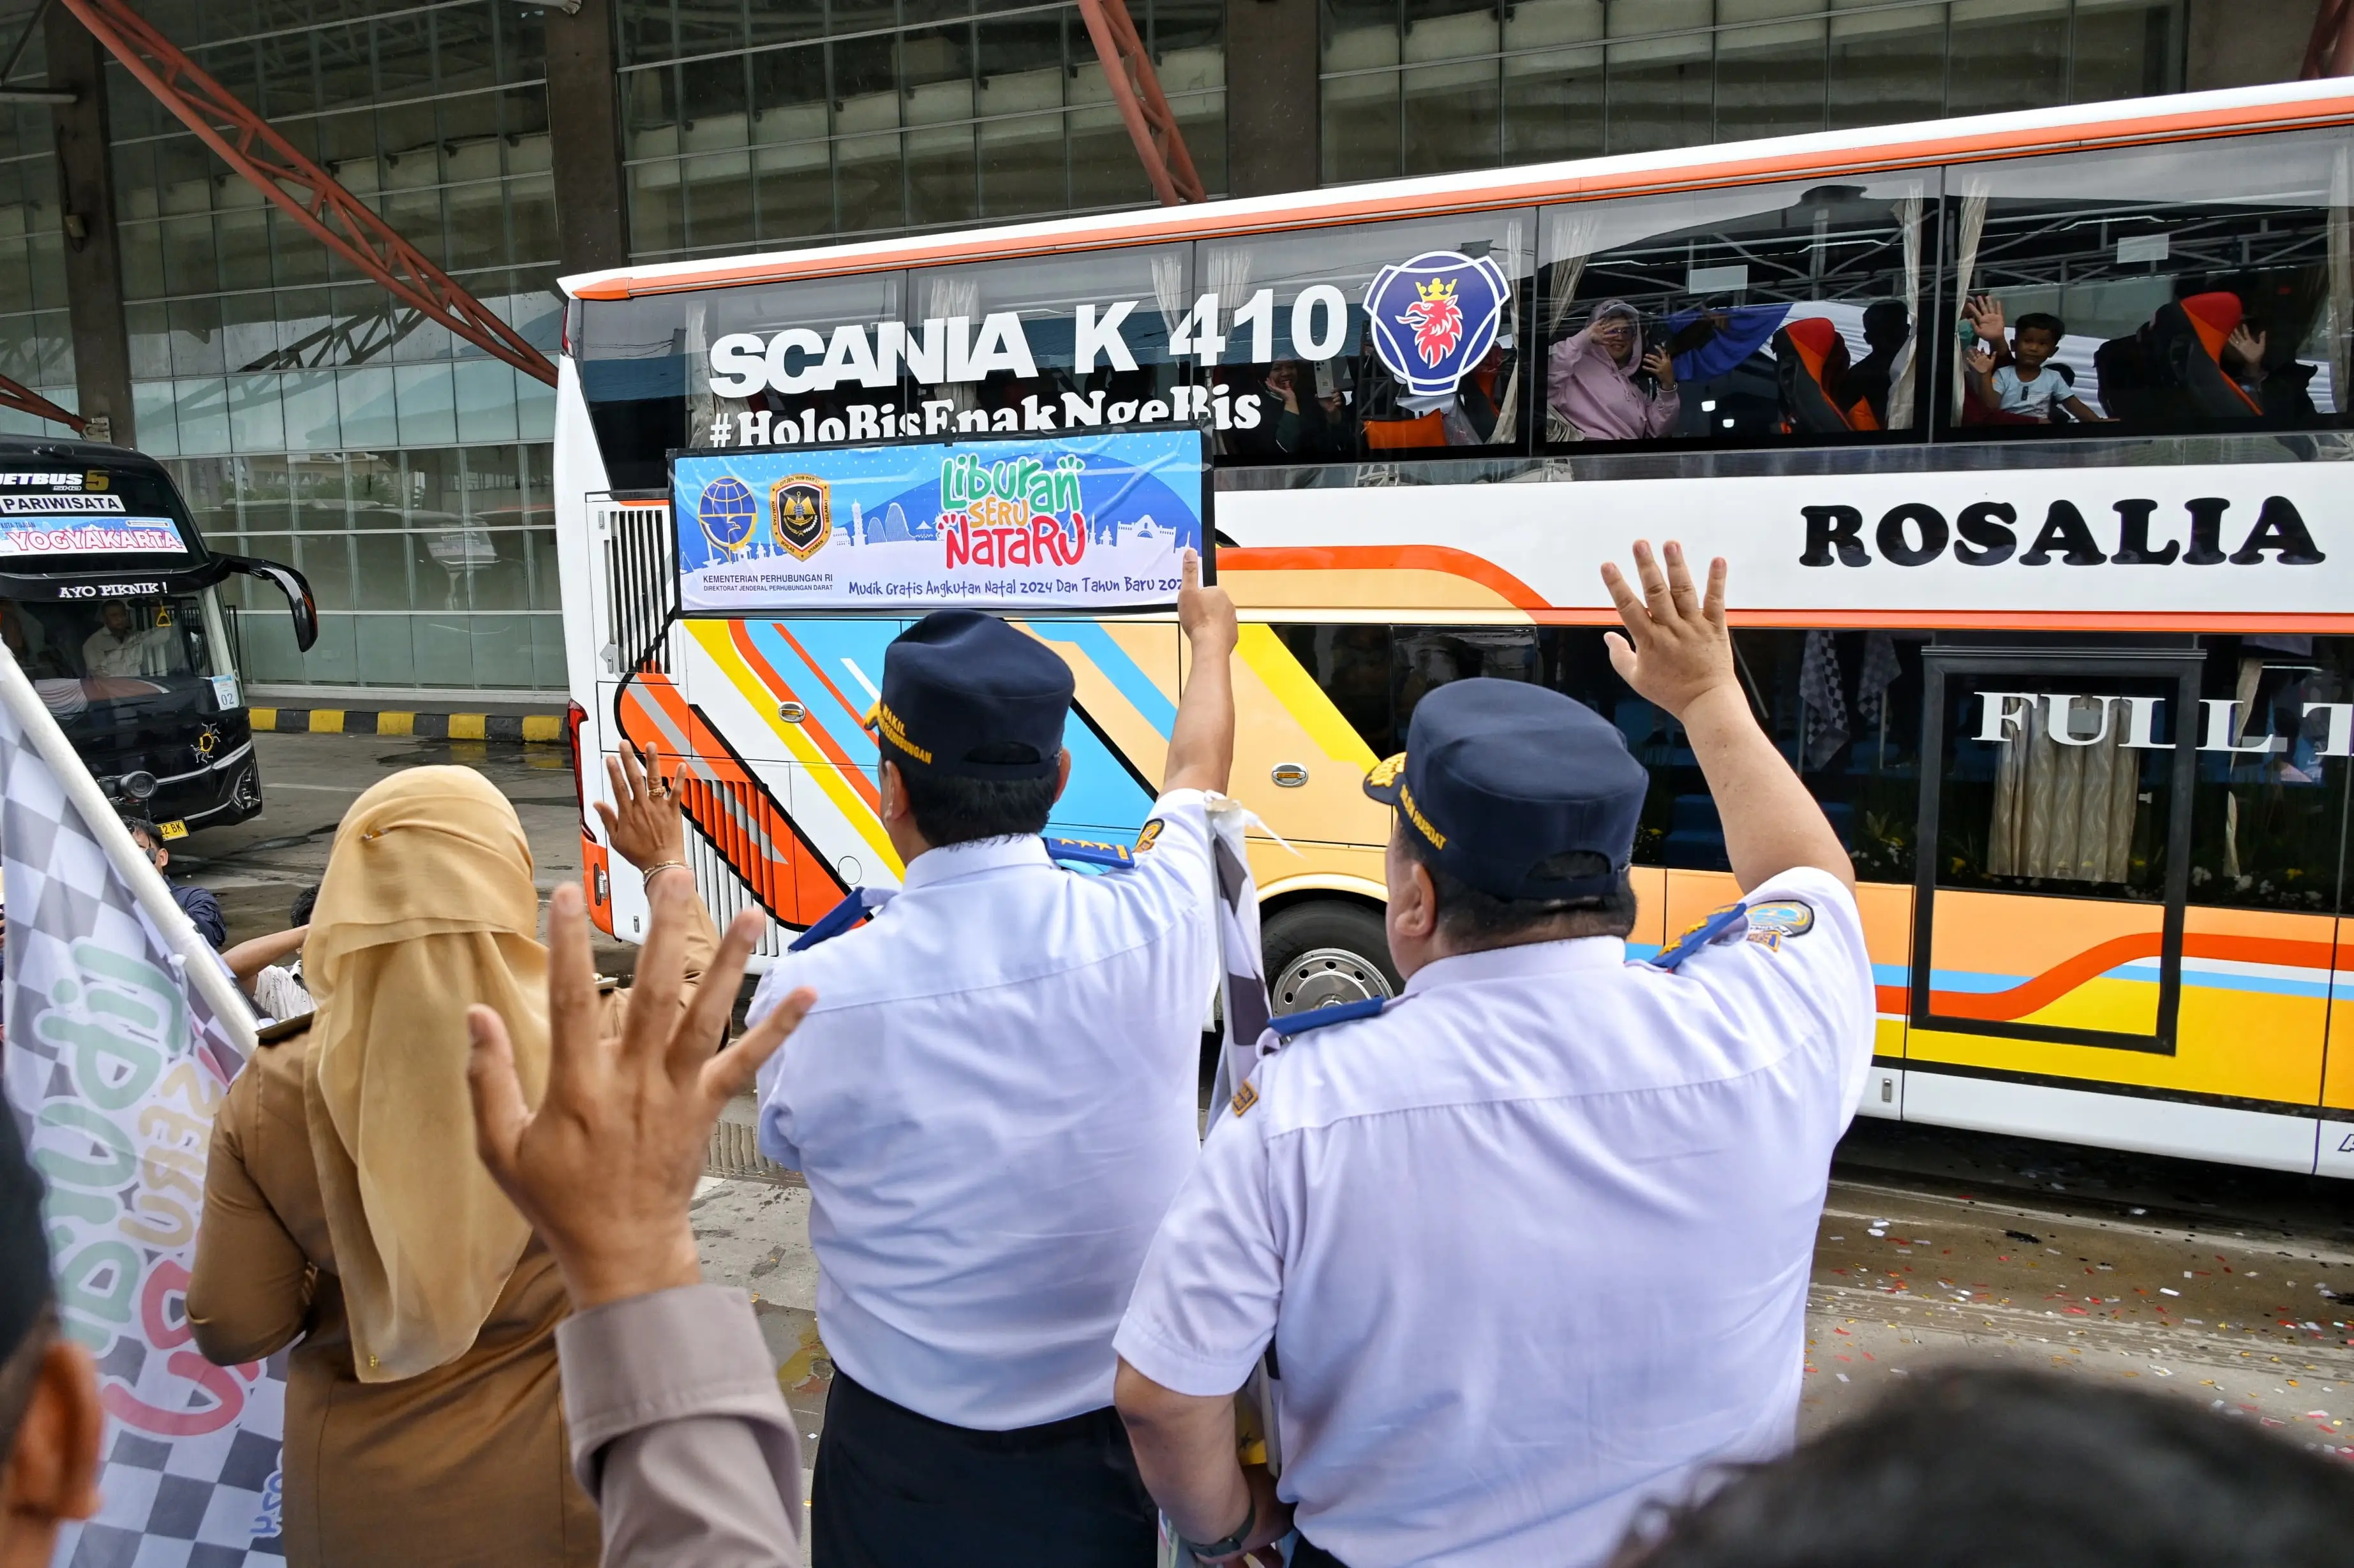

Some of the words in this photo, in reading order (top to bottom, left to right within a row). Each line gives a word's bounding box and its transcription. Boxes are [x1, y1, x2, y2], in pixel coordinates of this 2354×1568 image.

[709, 312, 1039, 399] SCANIA
[1075, 300, 1140, 374] K
[1169, 285, 1348, 367] 410
[86, 470, 109, 491] 5
[780, 477, 794, 485] DITJEN
[3, 498, 120, 510] PARIWISATA
[968, 496, 1028, 528] SERU
[1798, 496, 2326, 568] ROSALIA
[5, 531, 183, 551] YOGYAKARTA
[780, 540, 795, 553] IKHLAS
[808, 540, 824, 554] NYAMAN
[761, 574, 823, 582] PERHUBUNGAN
[59, 586, 96, 598] AYO
[98, 582, 160, 596] PIKNIK
[162, 582, 168, 593] !
[849, 581, 883, 595] Mudik
[886, 582, 923, 598] Gratis
[926, 581, 981, 598] Angkutan
[985, 579, 1016, 598] Natal
[1020, 581, 1053, 593] 2024
[1056, 579, 1078, 593] Dan
[1081, 577, 1120, 593] Tahun
[1124, 577, 1155, 592] Baru
[221, 693, 234, 706] 02
[1970, 692, 2273, 753] FULL
[170, 822, 183, 833] BK
